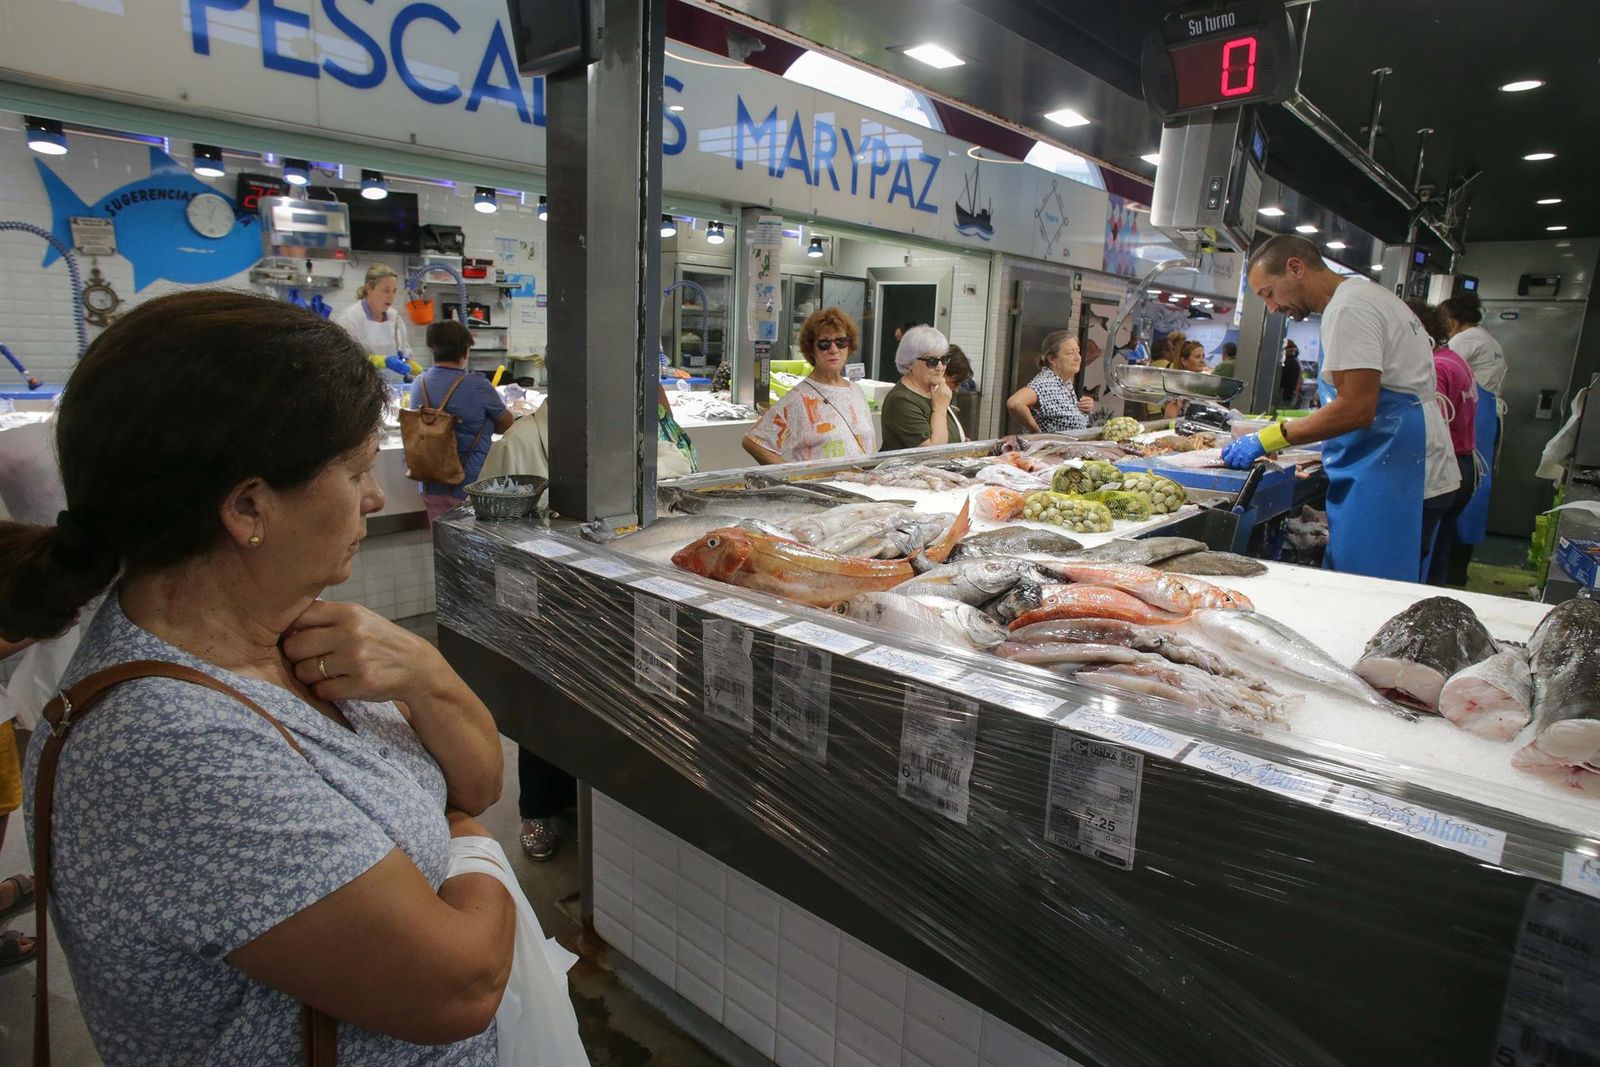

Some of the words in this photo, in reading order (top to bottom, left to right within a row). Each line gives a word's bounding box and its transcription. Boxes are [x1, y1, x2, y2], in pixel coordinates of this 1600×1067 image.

[1188, 19, 1202, 36] Su
[1205, 12, 1236, 33] turno
[1221, 37, 1257, 96] 0
[736, 93, 941, 214] MARYPAZ
[1087, 811, 1116, 831] 7.25
